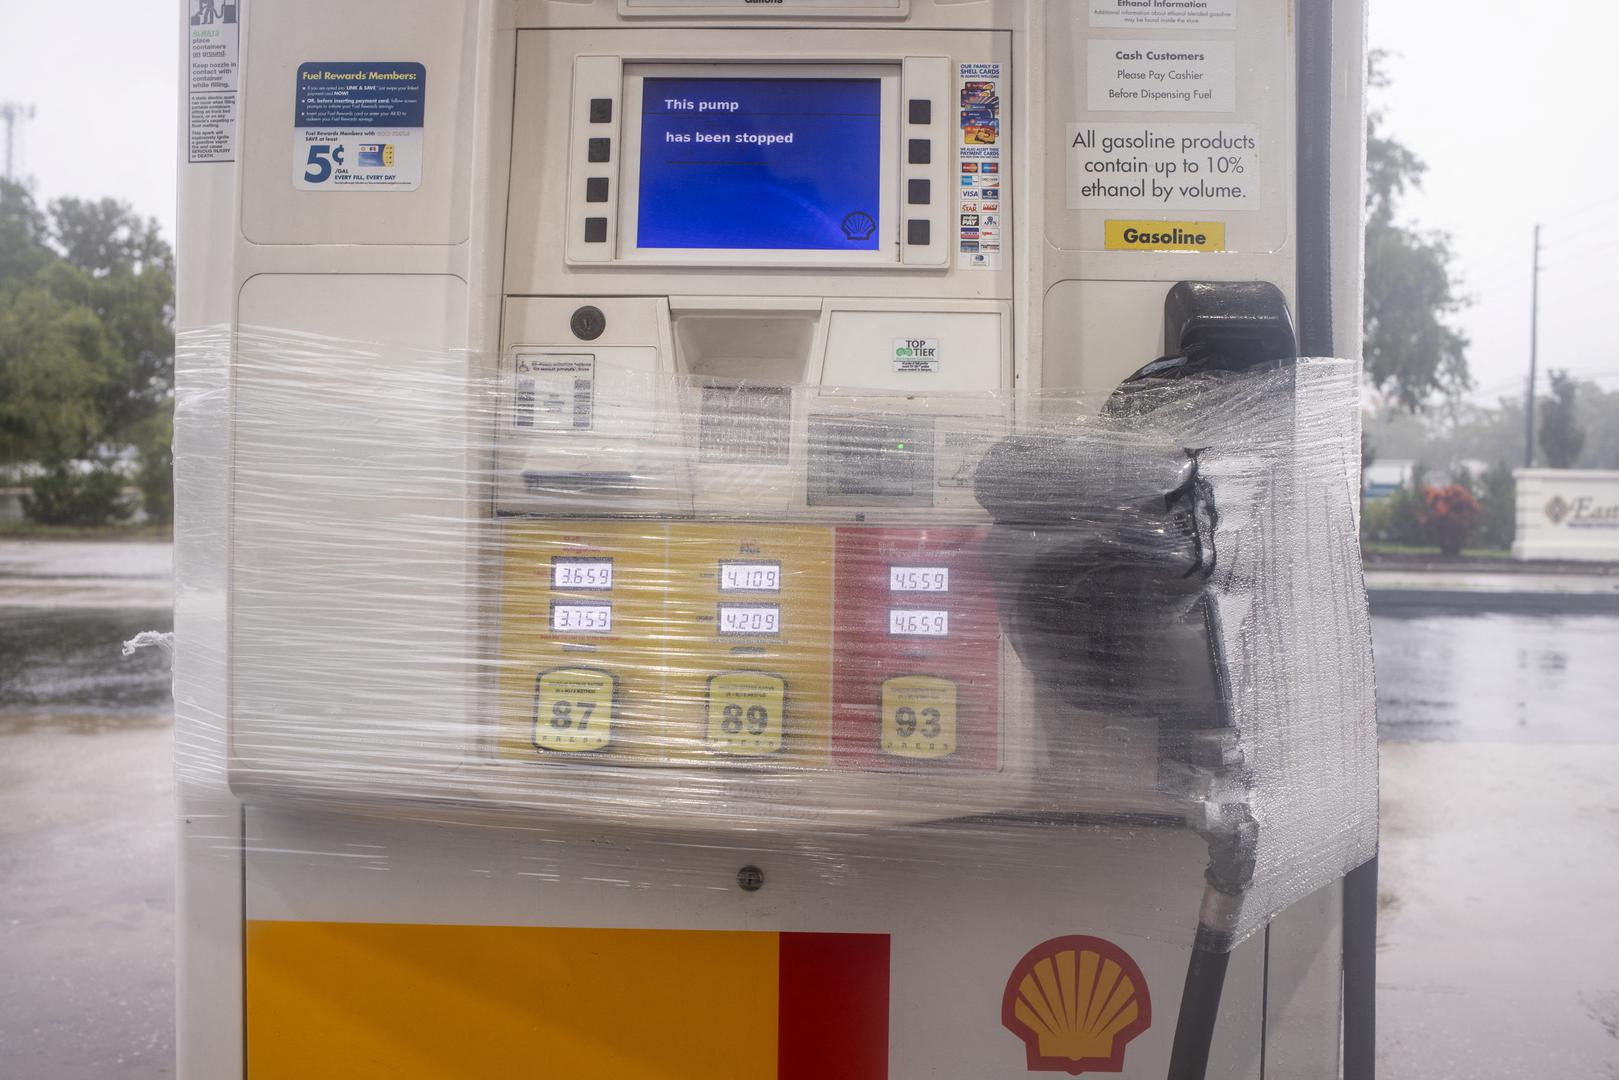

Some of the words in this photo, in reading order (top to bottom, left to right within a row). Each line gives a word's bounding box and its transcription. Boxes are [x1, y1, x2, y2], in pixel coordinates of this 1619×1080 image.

[1153, 0, 1207, 8] Information
[1115, 51, 1143, 61] Cash
[1146, 51, 1205, 61] Customers
[303, 71, 322, 80] Fuel
[368, 71, 417, 80] Members:
[1117, 70, 1146, 80] Please
[1149, 70, 1166, 82] Pay
[1168, 69, 1203, 80] Cashier
[1108, 88, 1138, 98] Before
[1141, 88, 1190, 101] Dispensing
[1193, 89, 1212, 99] Fuel
[664, 98, 694, 110] This
[699, 101, 739, 112] pump
[666, 131, 691, 142] has
[695, 131, 730, 142] been
[735, 132, 793, 145] stopped
[1072, 130, 1095, 148] All
[1102, 130, 1175, 153] gasoline
[1182, 130, 1255, 154] products
[1085, 156, 1148, 173] contain
[1155, 162, 1177, 178] up
[1183, 159, 1199, 173] to
[1207, 156, 1244, 174] 10%
[1081, 178, 1145, 197] ethanol
[1152, 178, 1174, 203] by
[1179, 179, 1246, 198] volume.
[1123, 228, 1206, 245] Gasoline
[905, 340, 926, 348] TOP
[562, 567, 609, 584] 3.659
[728, 570, 775, 587] 4.109
[896, 573, 944, 589] 4.559
[560, 610, 608, 627] 3.759
[727, 613, 775, 630] 4.209
[895, 616, 944, 633] 4.659
[550, 700, 597, 731] 87
[721, 703, 769, 735] 89
[895, 706, 941, 738] 93
